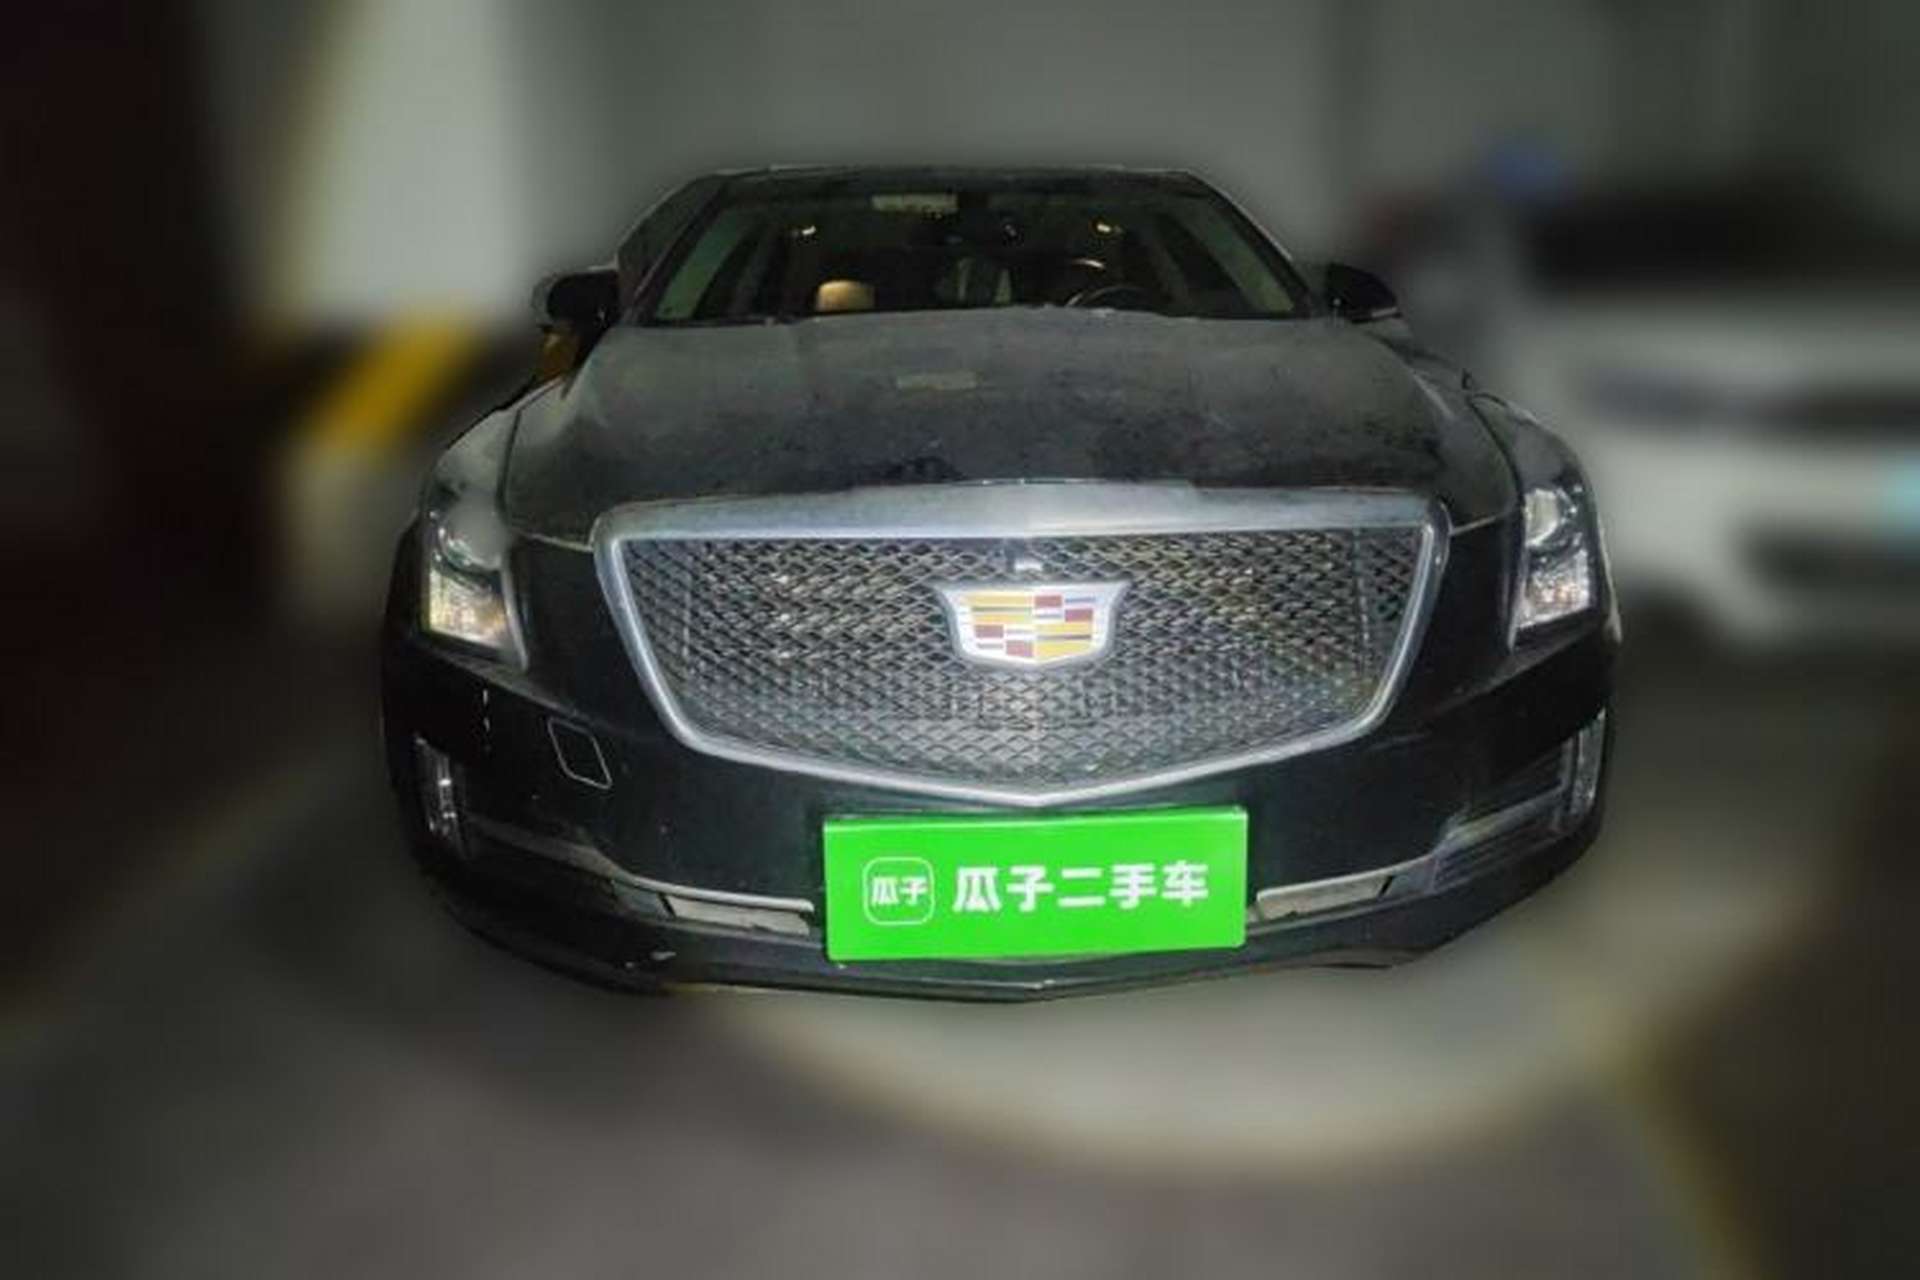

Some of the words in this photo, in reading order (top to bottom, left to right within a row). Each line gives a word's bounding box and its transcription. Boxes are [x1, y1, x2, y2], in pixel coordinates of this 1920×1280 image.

[870, 875, 929, 906] 瓜子
[953, 860, 1209, 913] 瓜子二手车
